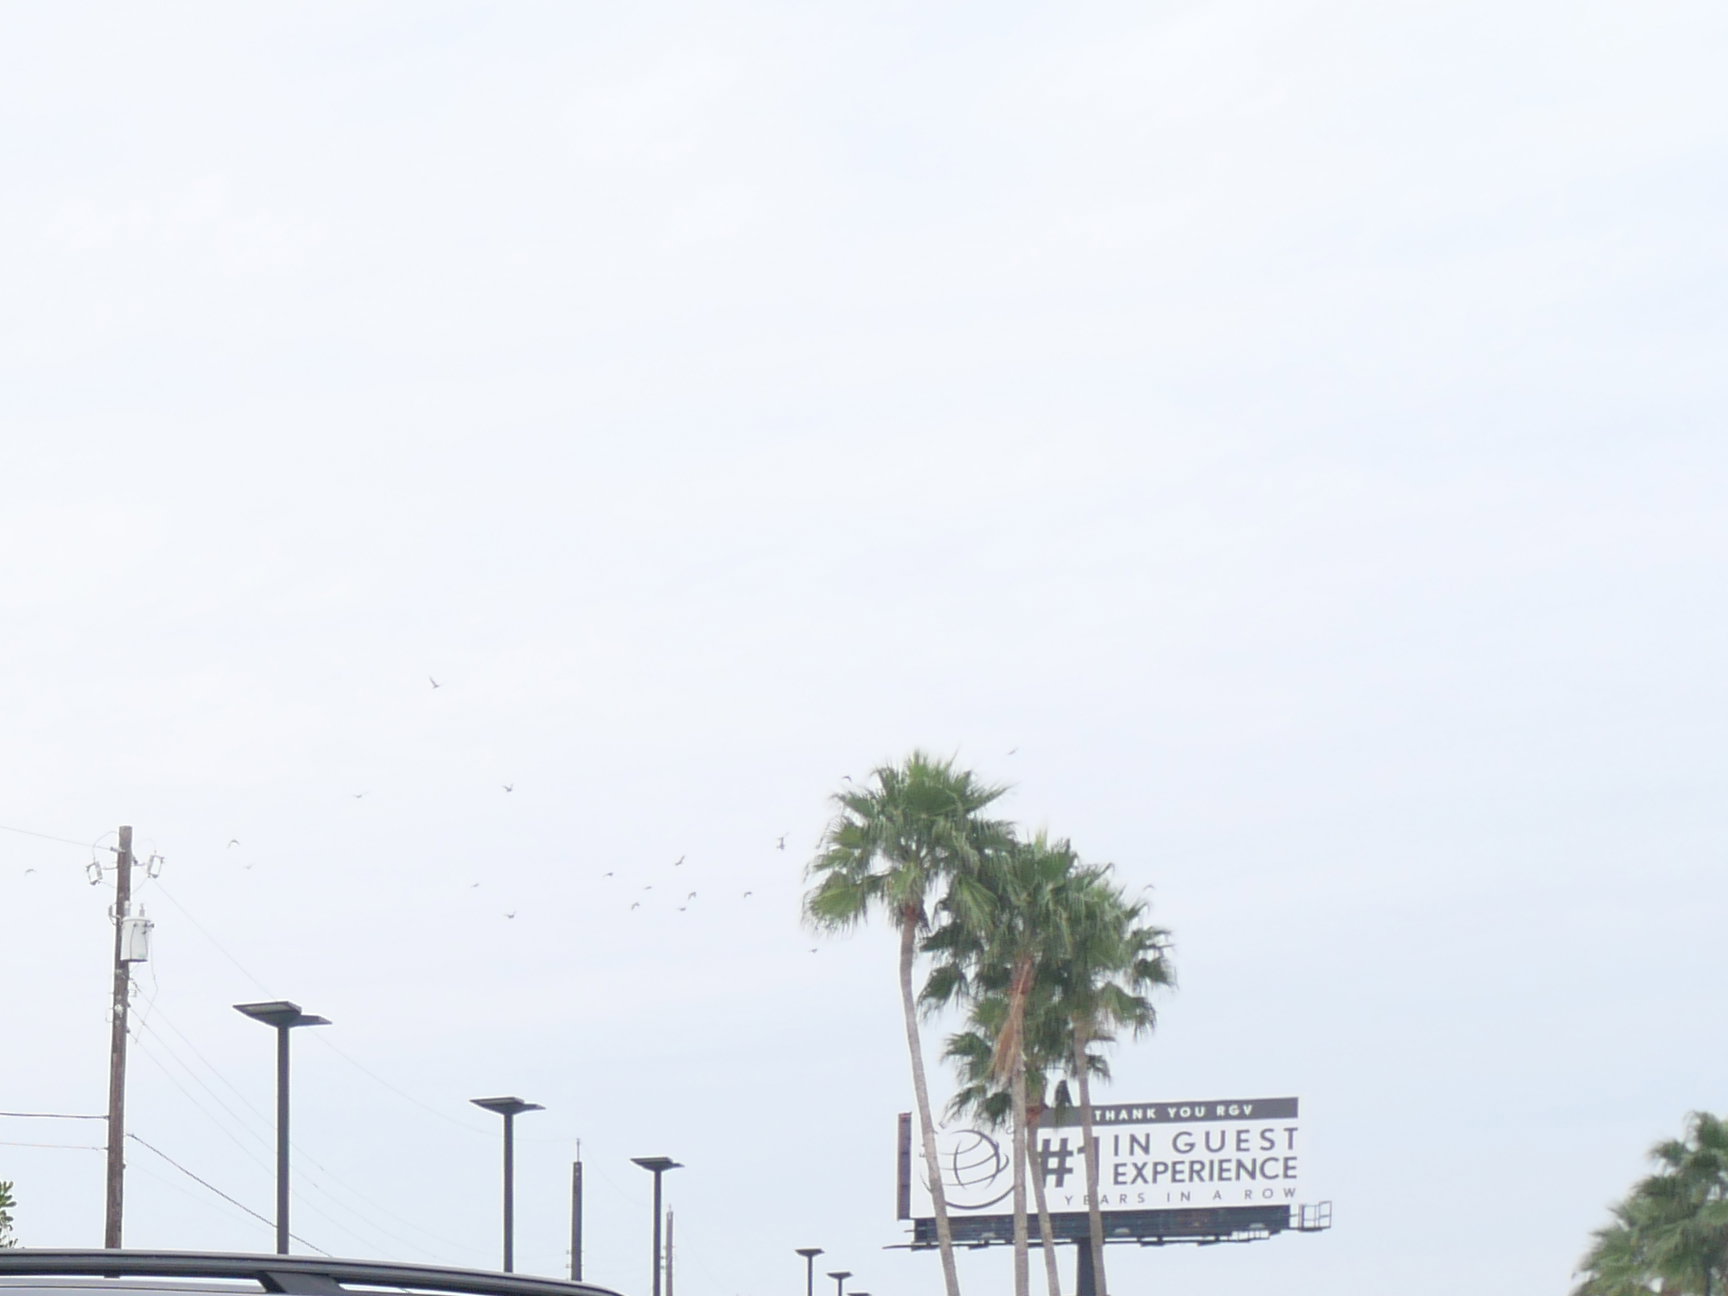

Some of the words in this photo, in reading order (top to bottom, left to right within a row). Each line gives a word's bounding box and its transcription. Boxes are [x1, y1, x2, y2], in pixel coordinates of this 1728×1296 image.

[1094, 1108, 1156, 1121] THANK
[1167, 1106, 1205, 1119] YOU
[1216, 1104, 1252, 1117] RGV
[1113, 1132, 1150, 1157] IN
[1172, 1127, 1298, 1154] GUEST
[1113, 1156, 1297, 1185] EXPERIENCE
[1065, 1192, 1146, 1205] YEARS
[1167, 1191, 1191, 1202] IN
[1212, 1189, 1222, 1200] A
[1244, 1187, 1296, 1200] ROW
